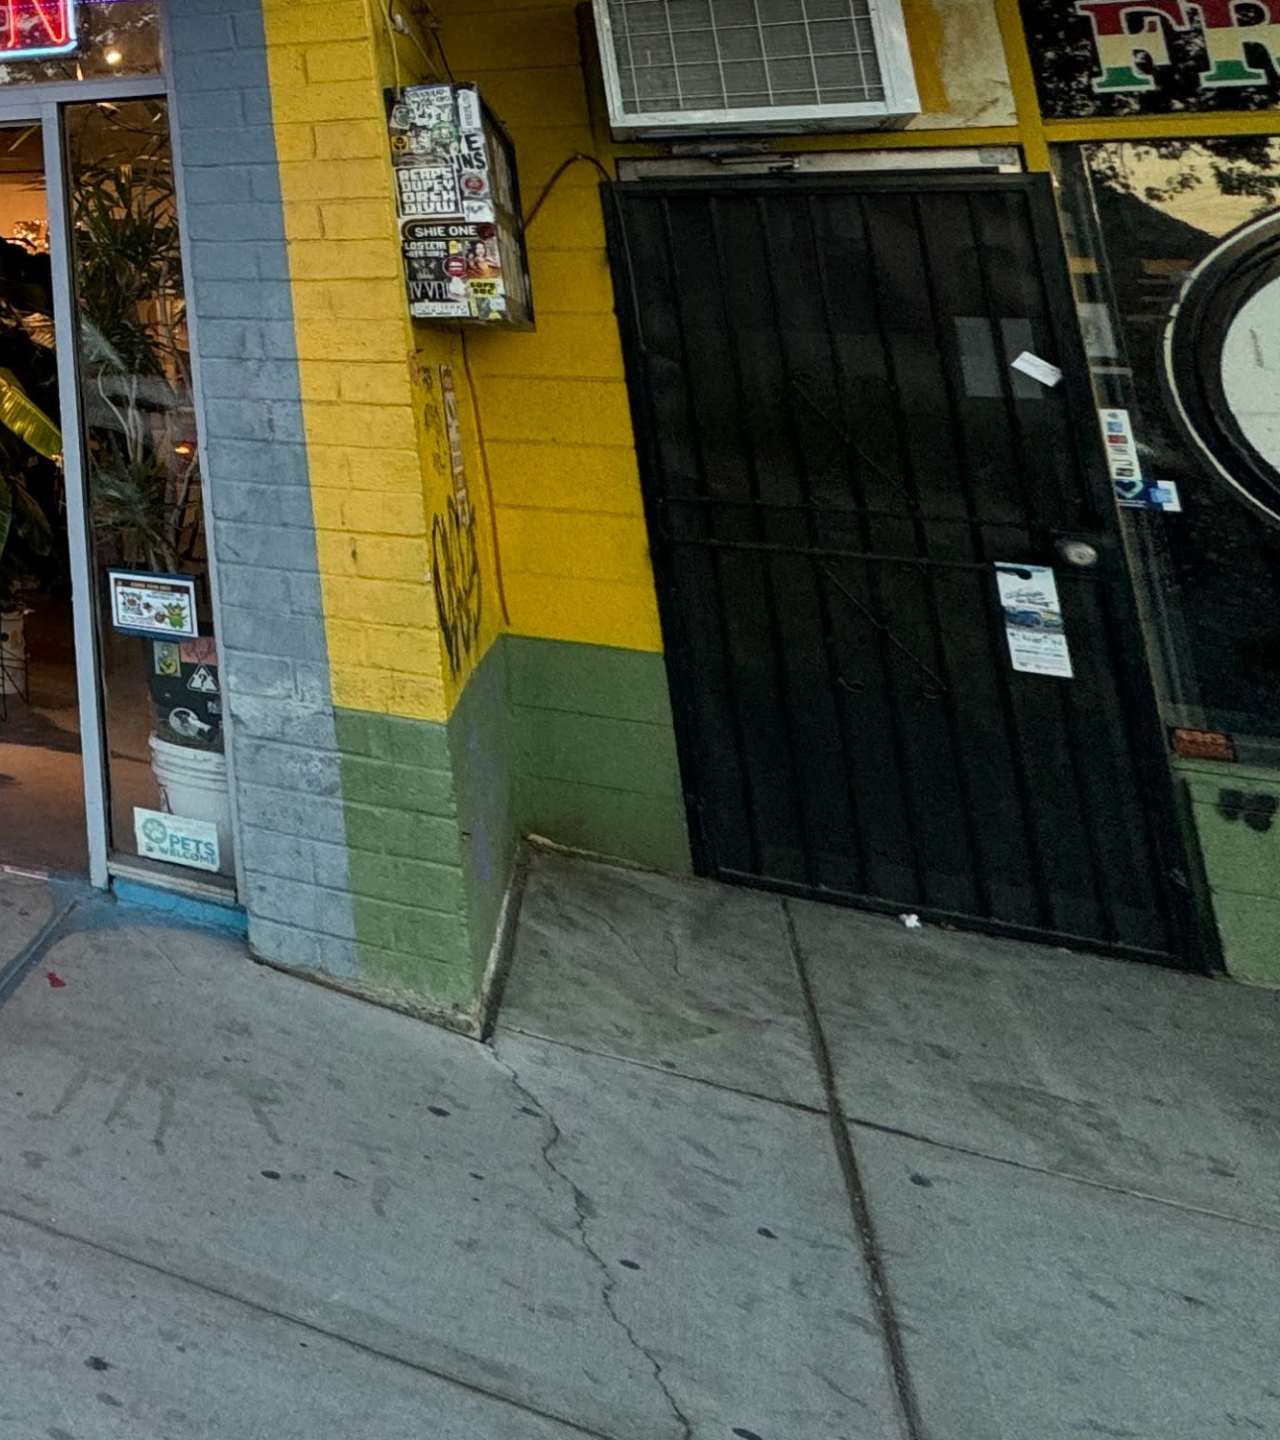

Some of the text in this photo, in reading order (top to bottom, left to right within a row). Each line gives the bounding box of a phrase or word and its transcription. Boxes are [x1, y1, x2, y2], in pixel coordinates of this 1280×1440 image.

[414, 225, 478, 238] SHIE ONE
[168, 833, 216, 857] PETS
